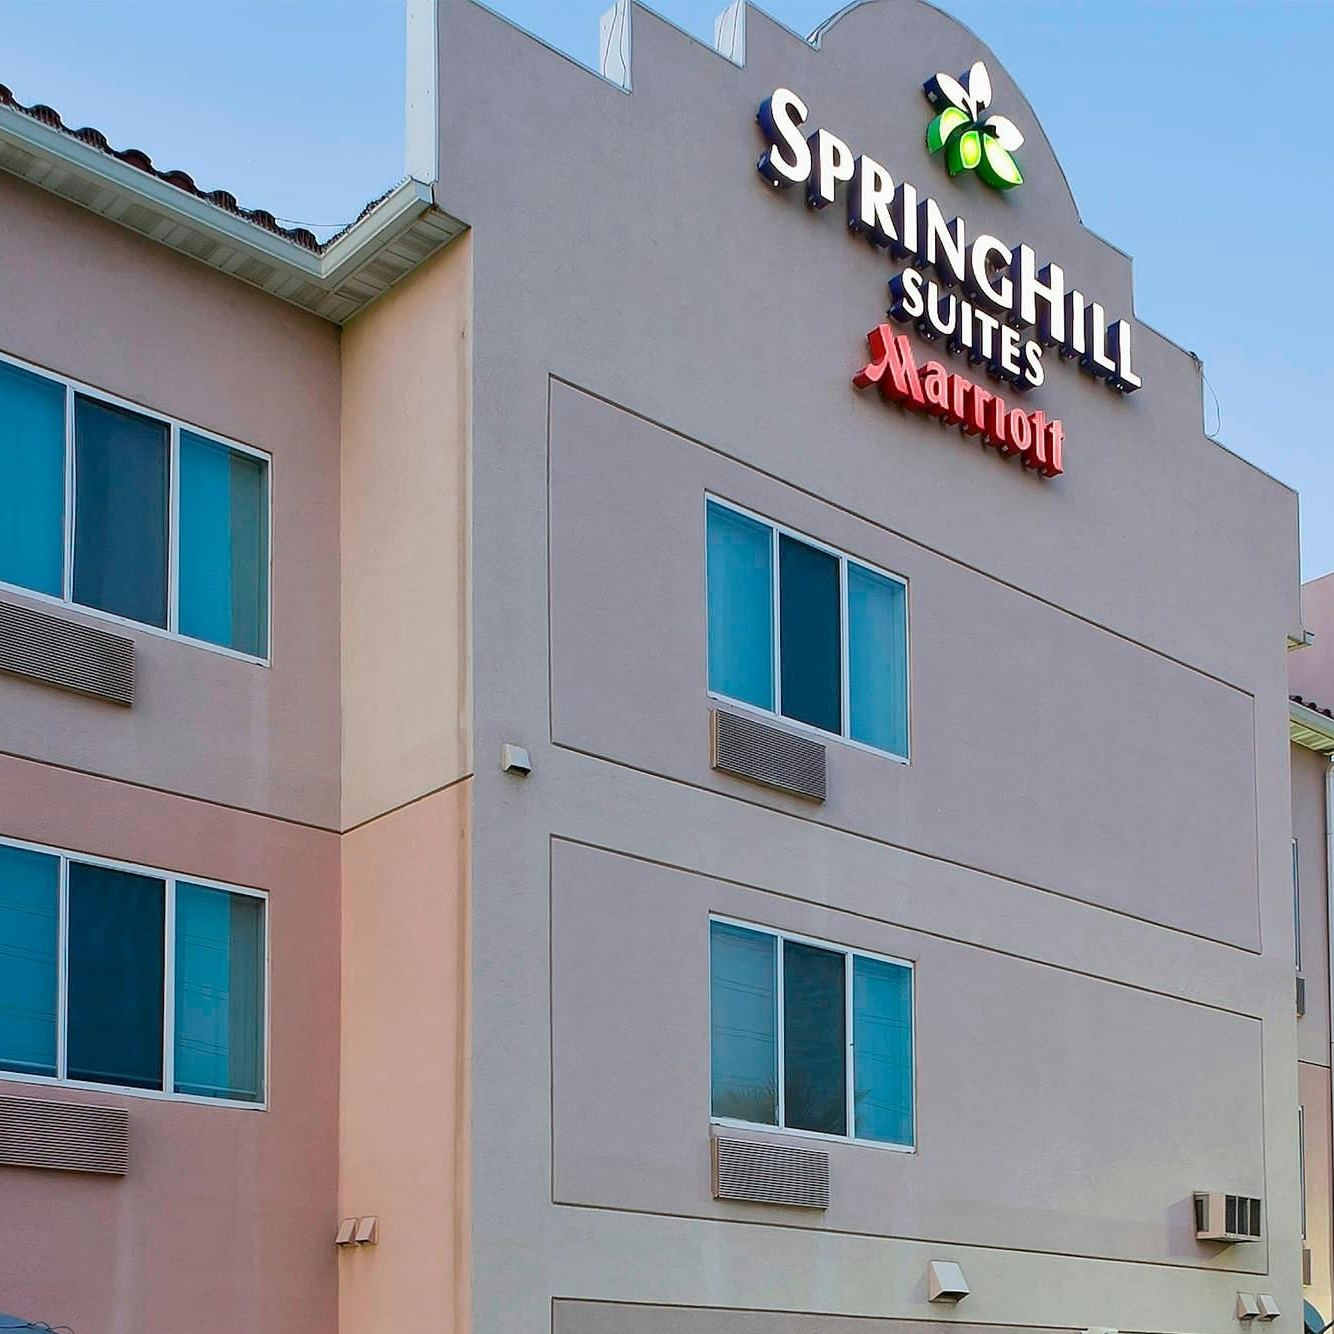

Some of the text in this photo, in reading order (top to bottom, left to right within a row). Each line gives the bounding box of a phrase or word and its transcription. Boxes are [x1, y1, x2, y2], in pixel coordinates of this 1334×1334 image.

[759, 87, 1142, 391] SPRINGHILL
[855, 323, 1065, 477] Marriott
[891, 267, 1044, 388] SUITES
